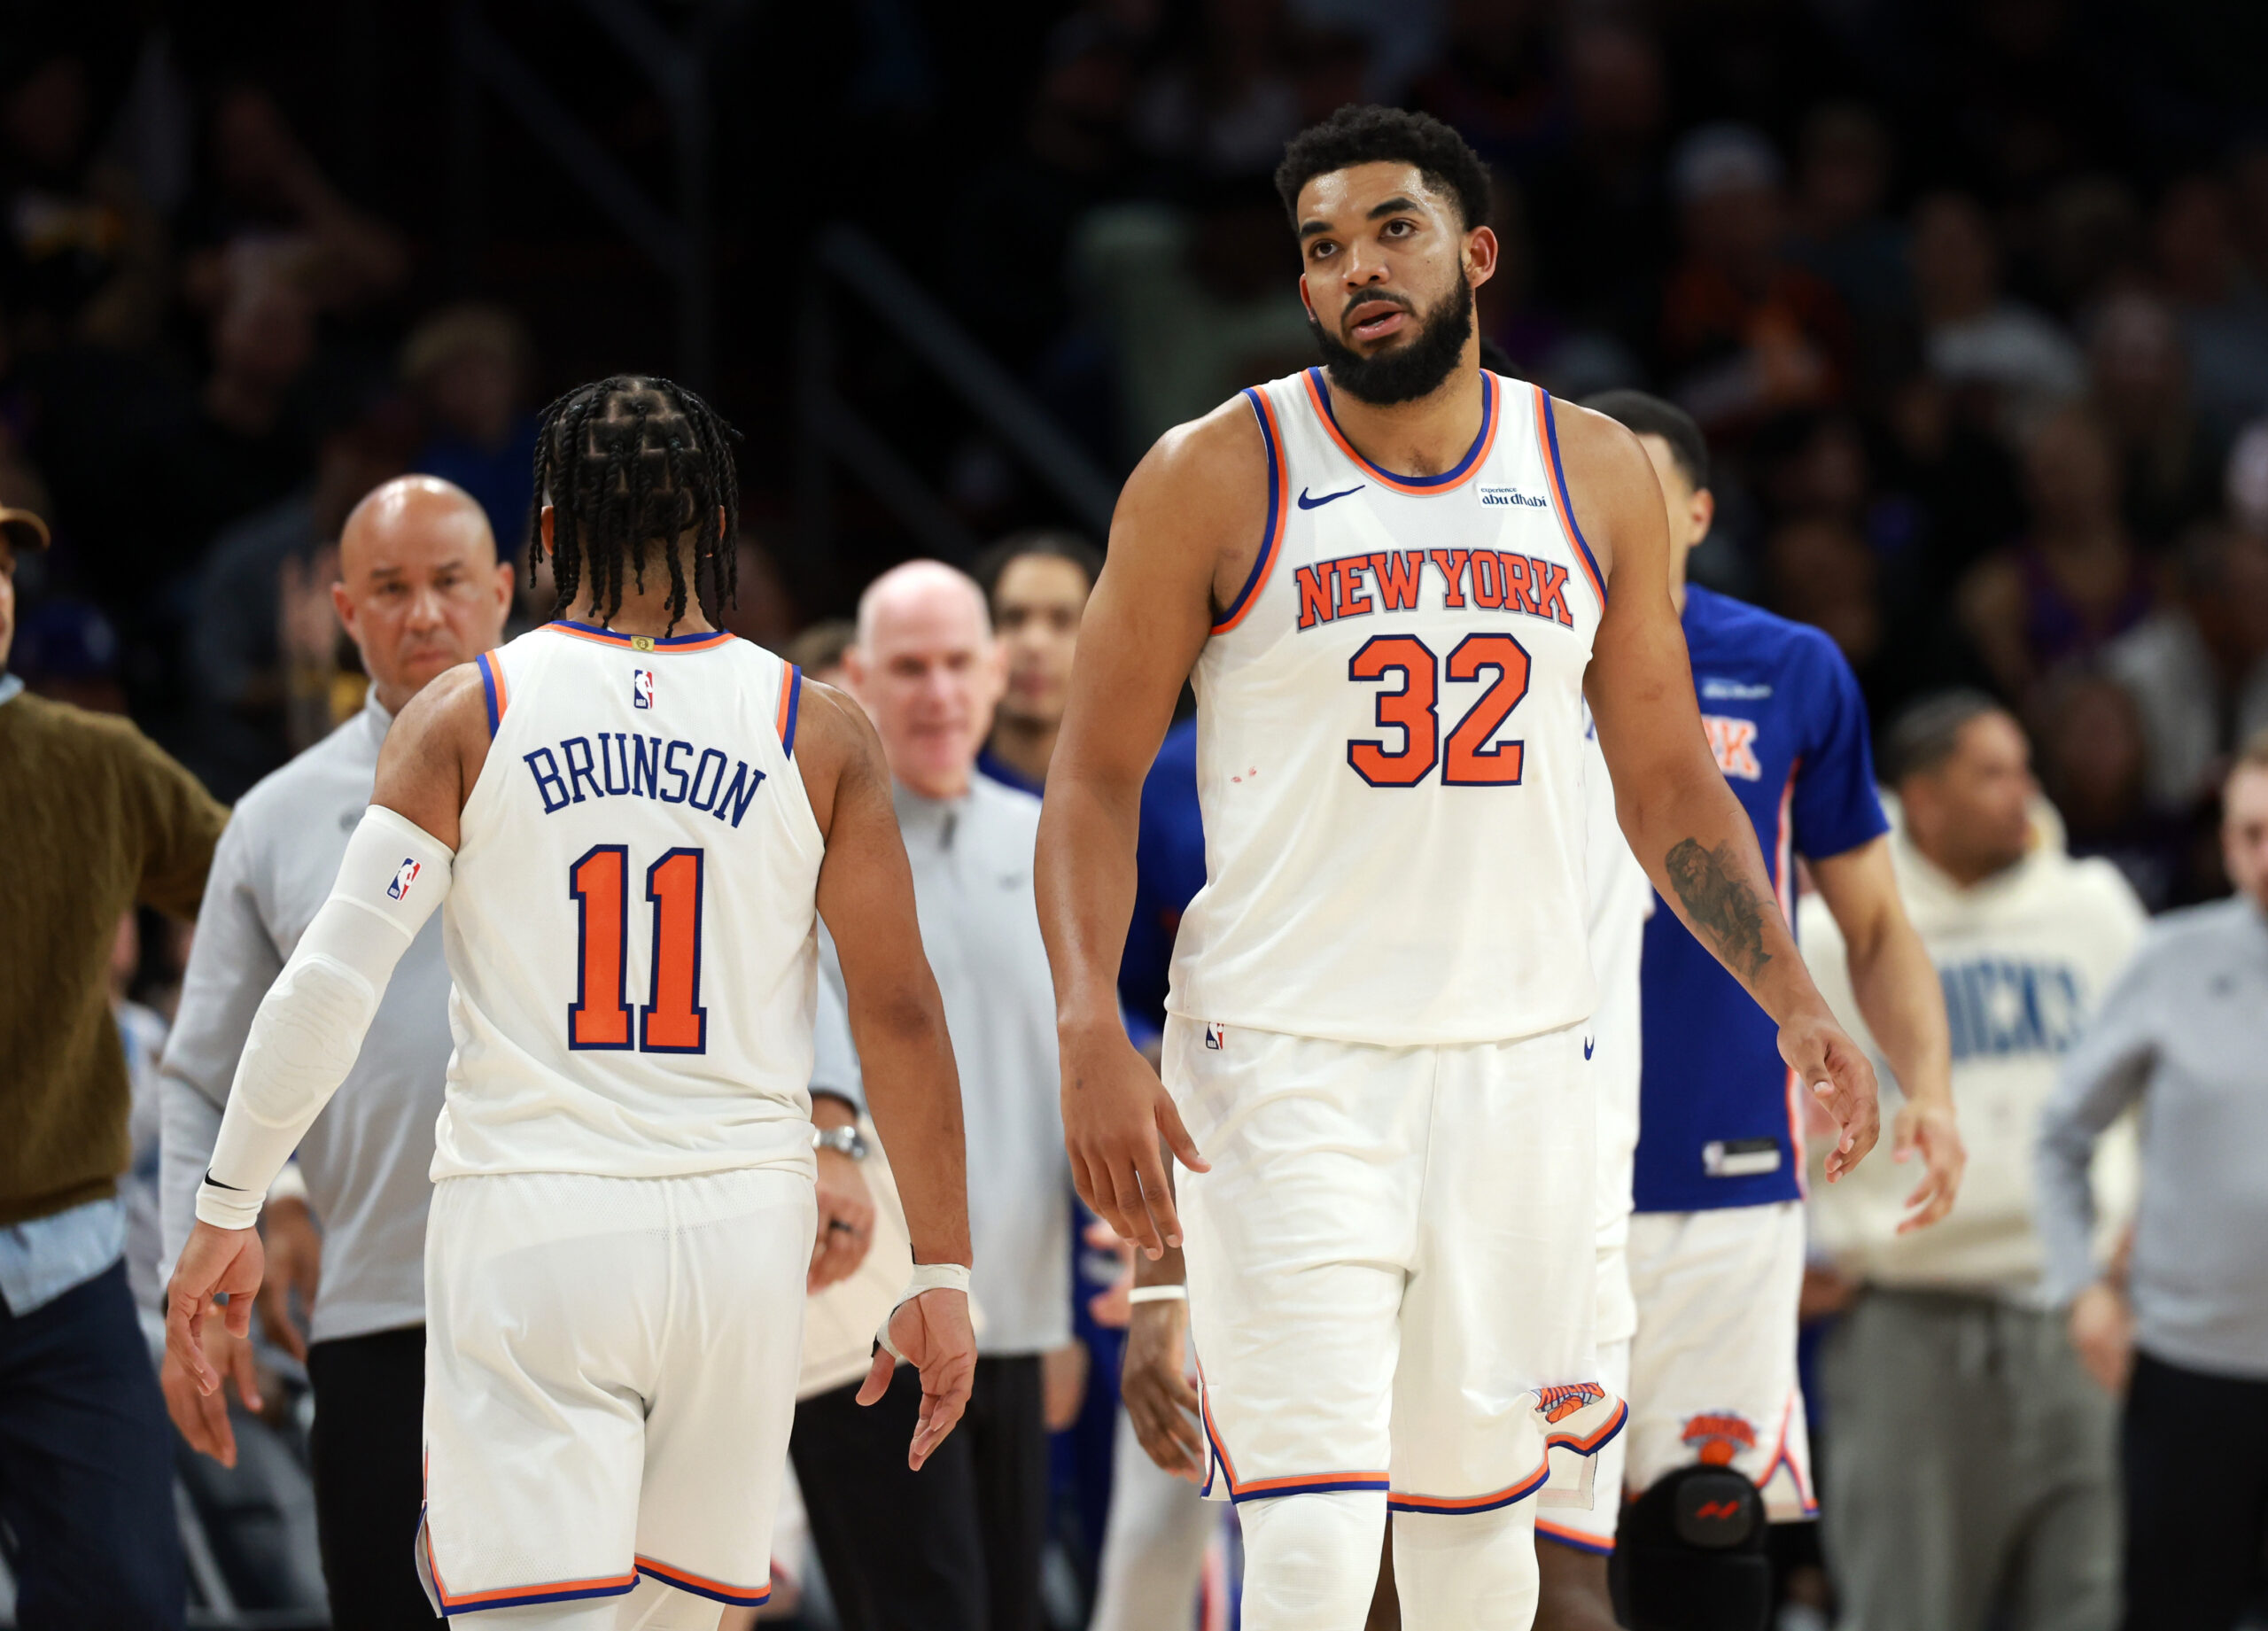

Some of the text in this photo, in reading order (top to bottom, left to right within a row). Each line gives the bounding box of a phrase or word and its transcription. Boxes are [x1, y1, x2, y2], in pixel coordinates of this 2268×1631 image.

[1482, 493, 1548, 508] abu dhabi
[1293, 548, 1574, 633] NEW YORK
[1348, 633, 1532, 788] 32
[523, 733, 766, 828] BRUNSON
[568, 844, 707, 1055] 11
